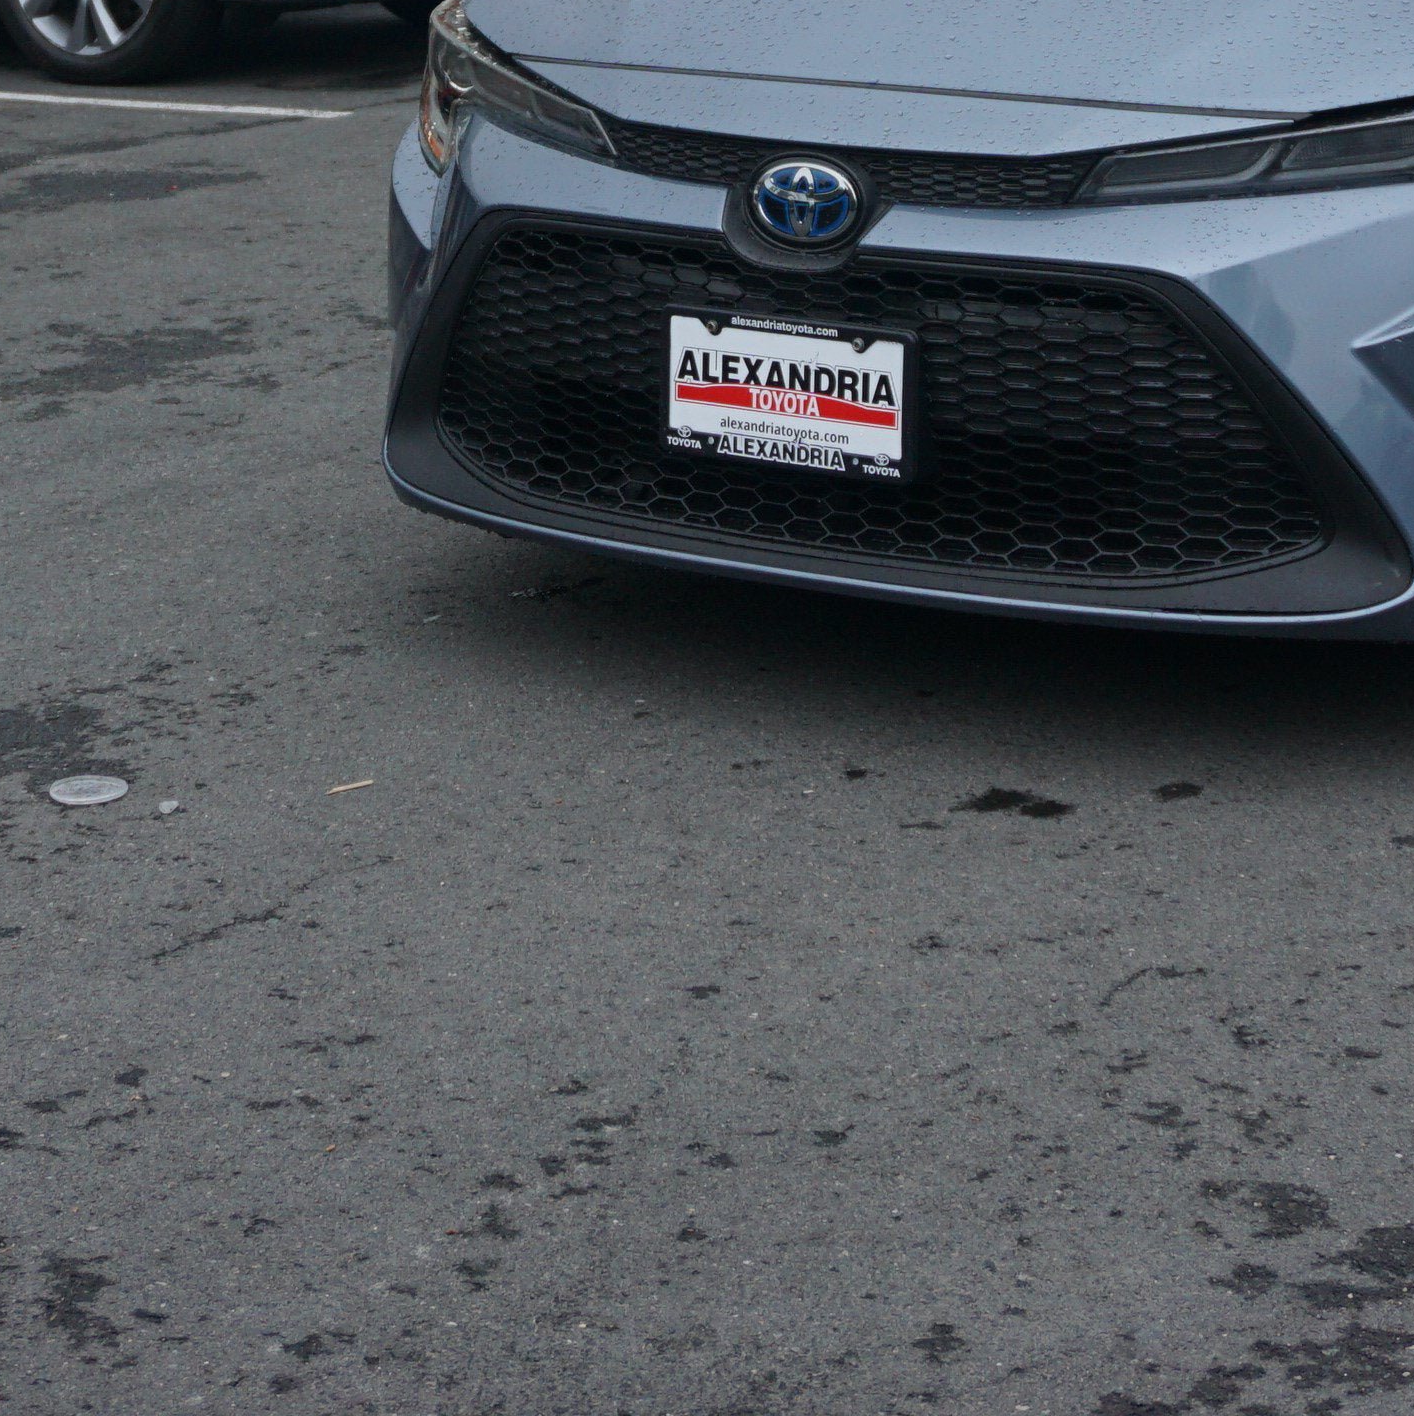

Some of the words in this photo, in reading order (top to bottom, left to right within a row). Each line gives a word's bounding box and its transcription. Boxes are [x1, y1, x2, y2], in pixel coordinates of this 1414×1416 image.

[731, 315, 839, 338] alexandriatoyota.com
[676, 348, 898, 408] ALEXANDRIA
[749, 388, 821, 417] TOYOTA
[667, 436, 702, 450] TOYOTA
[720, 416, 850, 445] alexandriatoyota.com
[717, 434, 846, 471] ALEXANDRIA
[862, 464, 901, 478] TOYOTA
